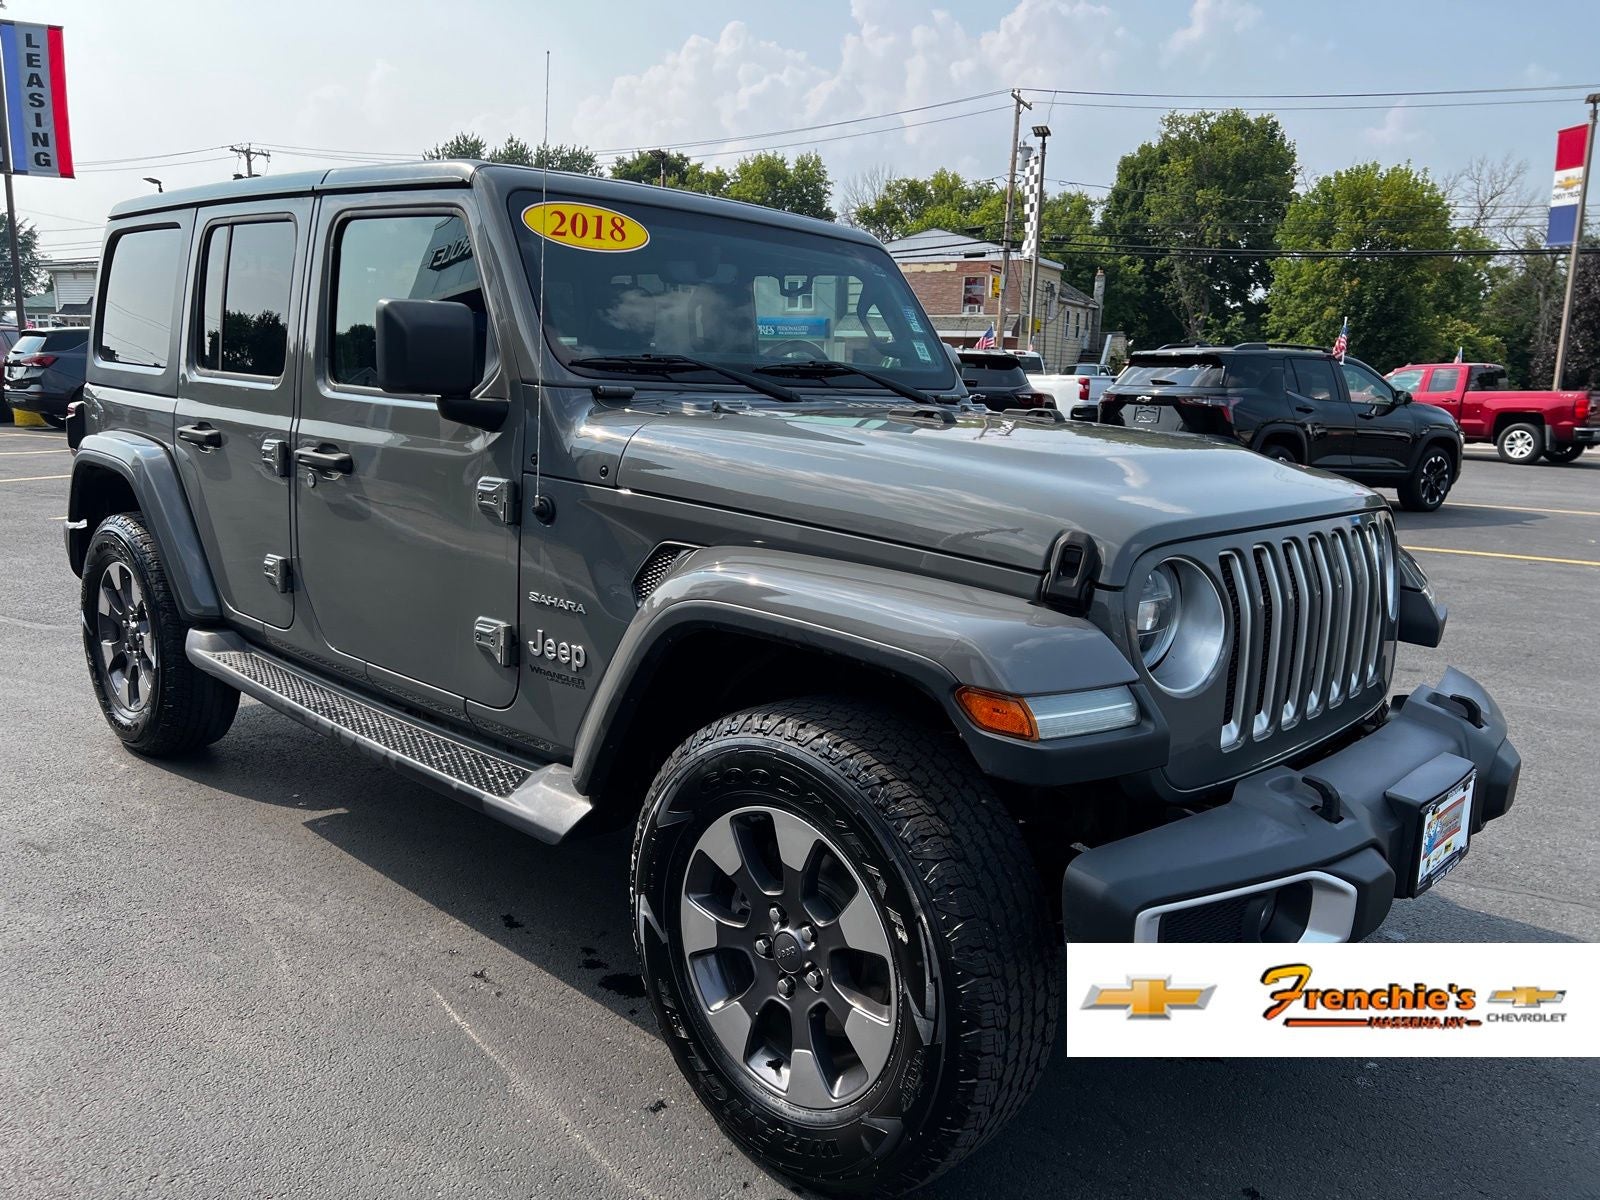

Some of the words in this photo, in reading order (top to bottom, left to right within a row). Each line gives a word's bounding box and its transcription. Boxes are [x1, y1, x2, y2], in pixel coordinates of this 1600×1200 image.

[25, 33, 51, 167] LEASING
[550, 209, 627, 243] 2018
[529, 591, 587, 615] SAHARA
[528, 629, 586, 672] Jeep
[529, 664, 586, 686] WRANGLER
